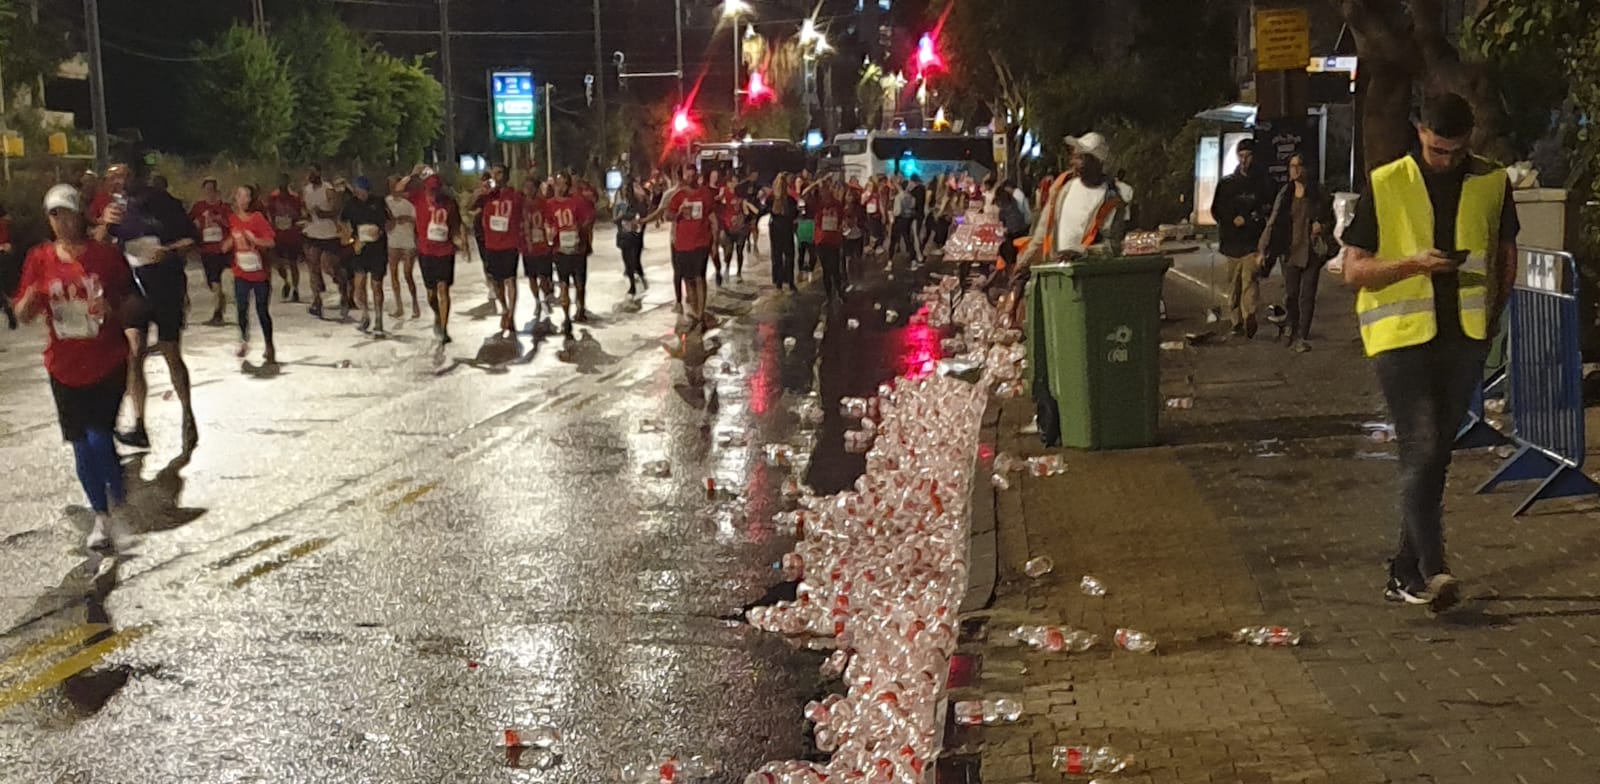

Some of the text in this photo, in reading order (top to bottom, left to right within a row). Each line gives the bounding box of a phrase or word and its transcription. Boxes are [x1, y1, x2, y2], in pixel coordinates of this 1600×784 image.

[428, 206, 447, 225] 10
[492, 201, 512, 217] 10
[555, 208, 573, 228] 10
